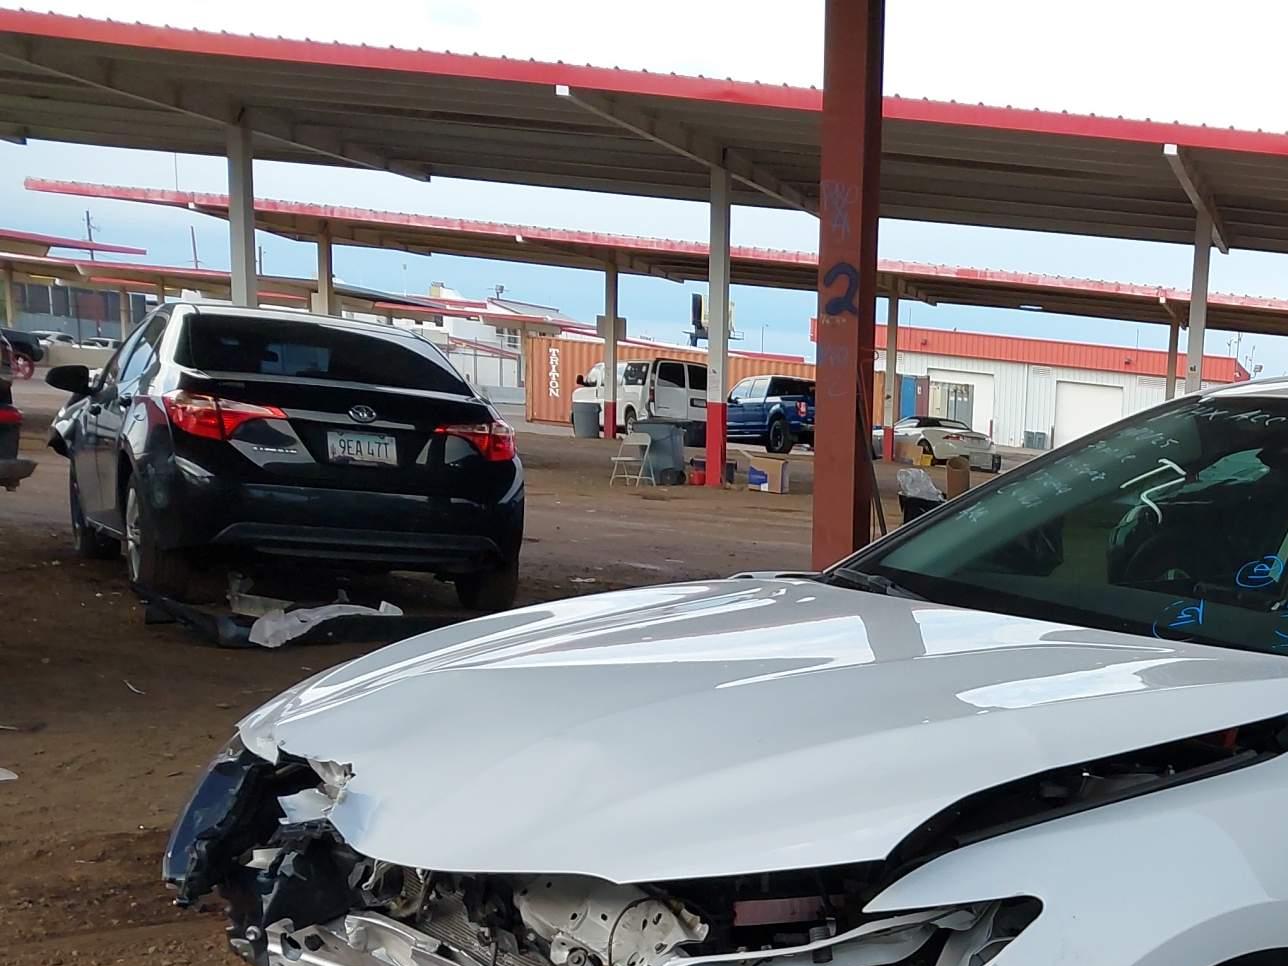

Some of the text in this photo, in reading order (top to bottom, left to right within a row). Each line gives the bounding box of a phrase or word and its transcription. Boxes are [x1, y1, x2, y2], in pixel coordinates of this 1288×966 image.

[823, 262, 859, 317] 2
[549, 347, 560, 398] TRITON
[338, 438, 390, 459] 9EA 47T
